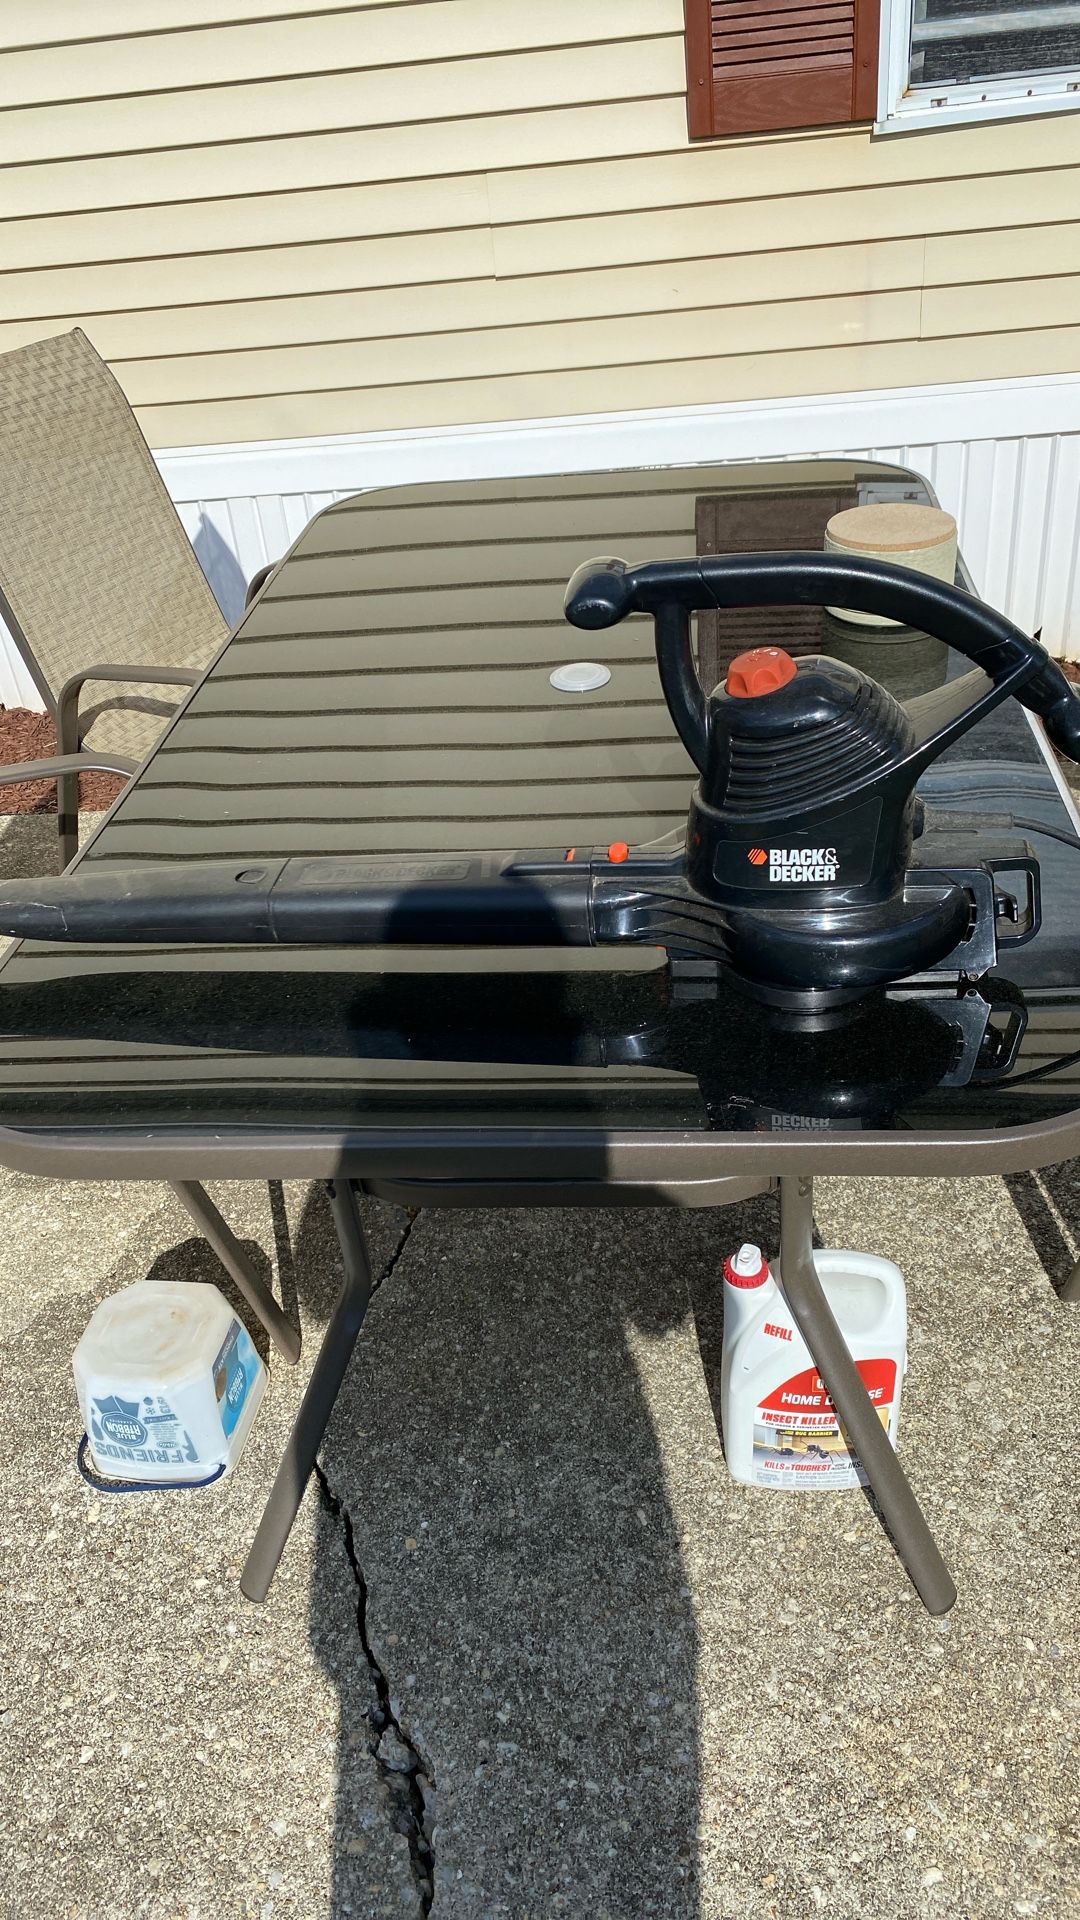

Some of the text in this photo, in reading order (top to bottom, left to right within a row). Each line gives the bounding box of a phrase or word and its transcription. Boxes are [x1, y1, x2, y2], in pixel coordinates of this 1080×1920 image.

[769, 847, 839, 866] BLACK&
[769, 865, 837, 882] DECKER
[764, 1322, 793, 1342] REFILL
[781, 1392, 822, 1406] HOME
[761, 1412, 836, 1426] INSECT KILLER
[105, 1421, 142, 1436] RIBBON
[115, 1432, 137, 1440] BLUE
[94, 1441, 184, 1464] FRIENDS
[764, 1461, 785, 1470] KILLS
[791, 1463, 832, 1472] TOUGHEST
